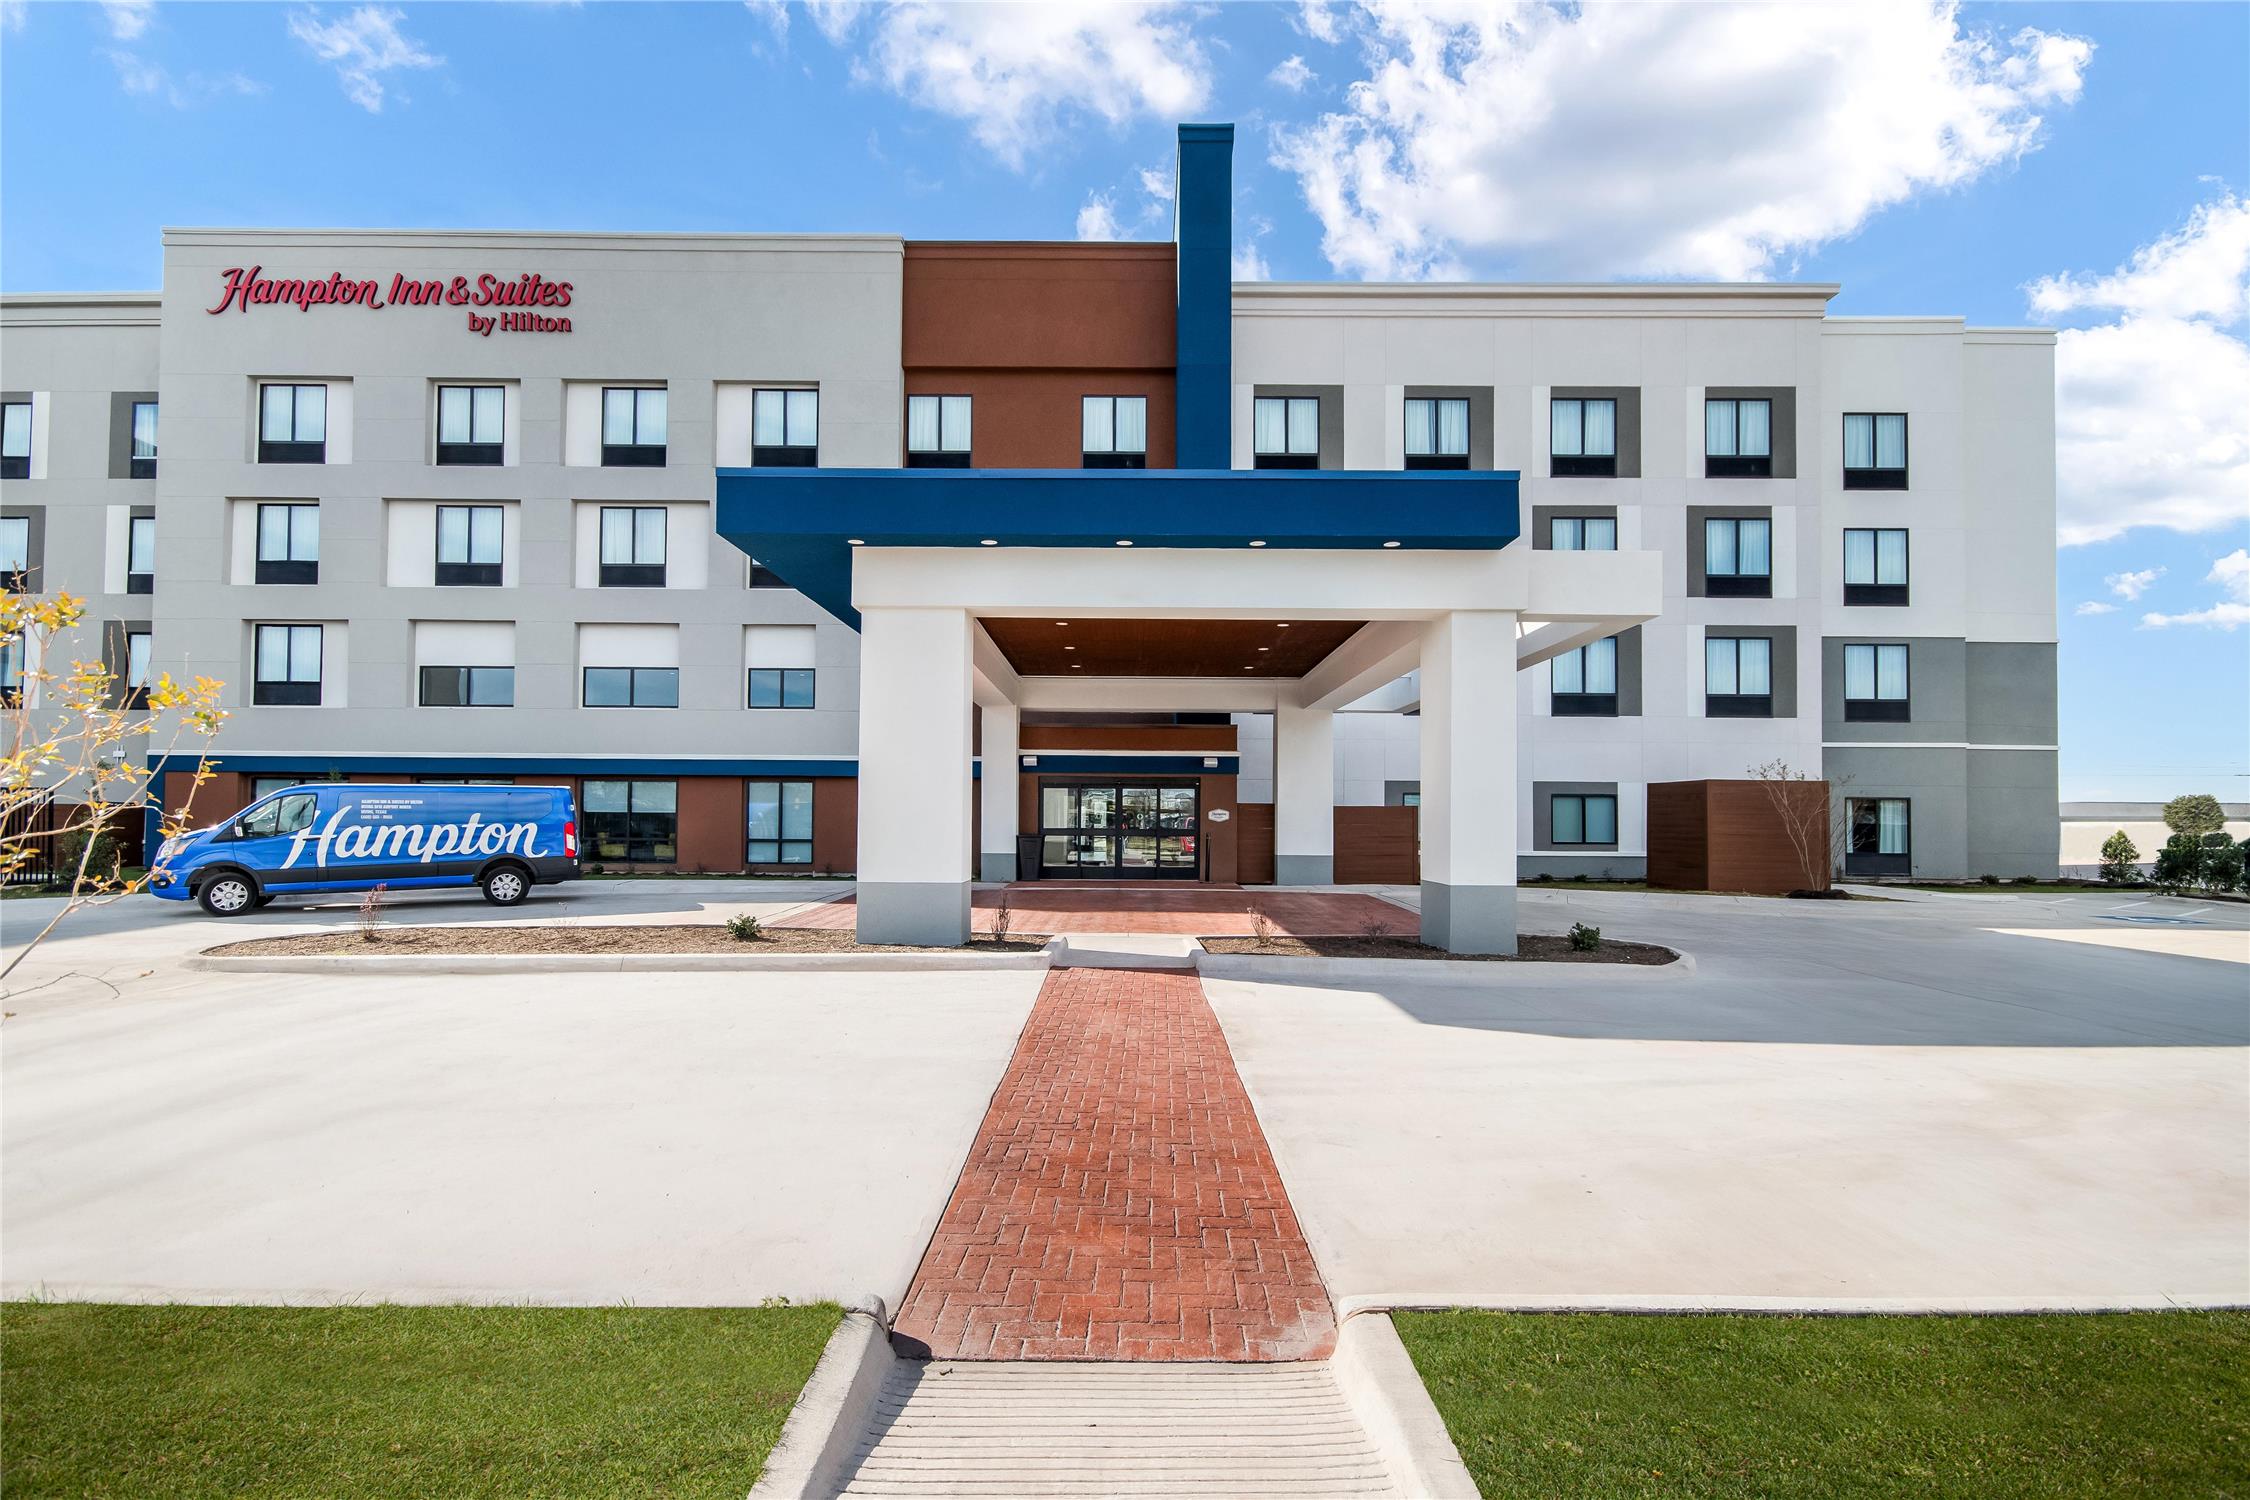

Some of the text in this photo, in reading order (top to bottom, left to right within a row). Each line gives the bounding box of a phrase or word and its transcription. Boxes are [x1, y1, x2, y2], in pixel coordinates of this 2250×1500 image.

[206, 265, 384, 315] Hampton
[387, 272, 444, 305] Inn
[471, 273, 574, 307] Suites
[468, 311, 572, 337] by Hilton
[279, 805, 548, 870] Hampton
